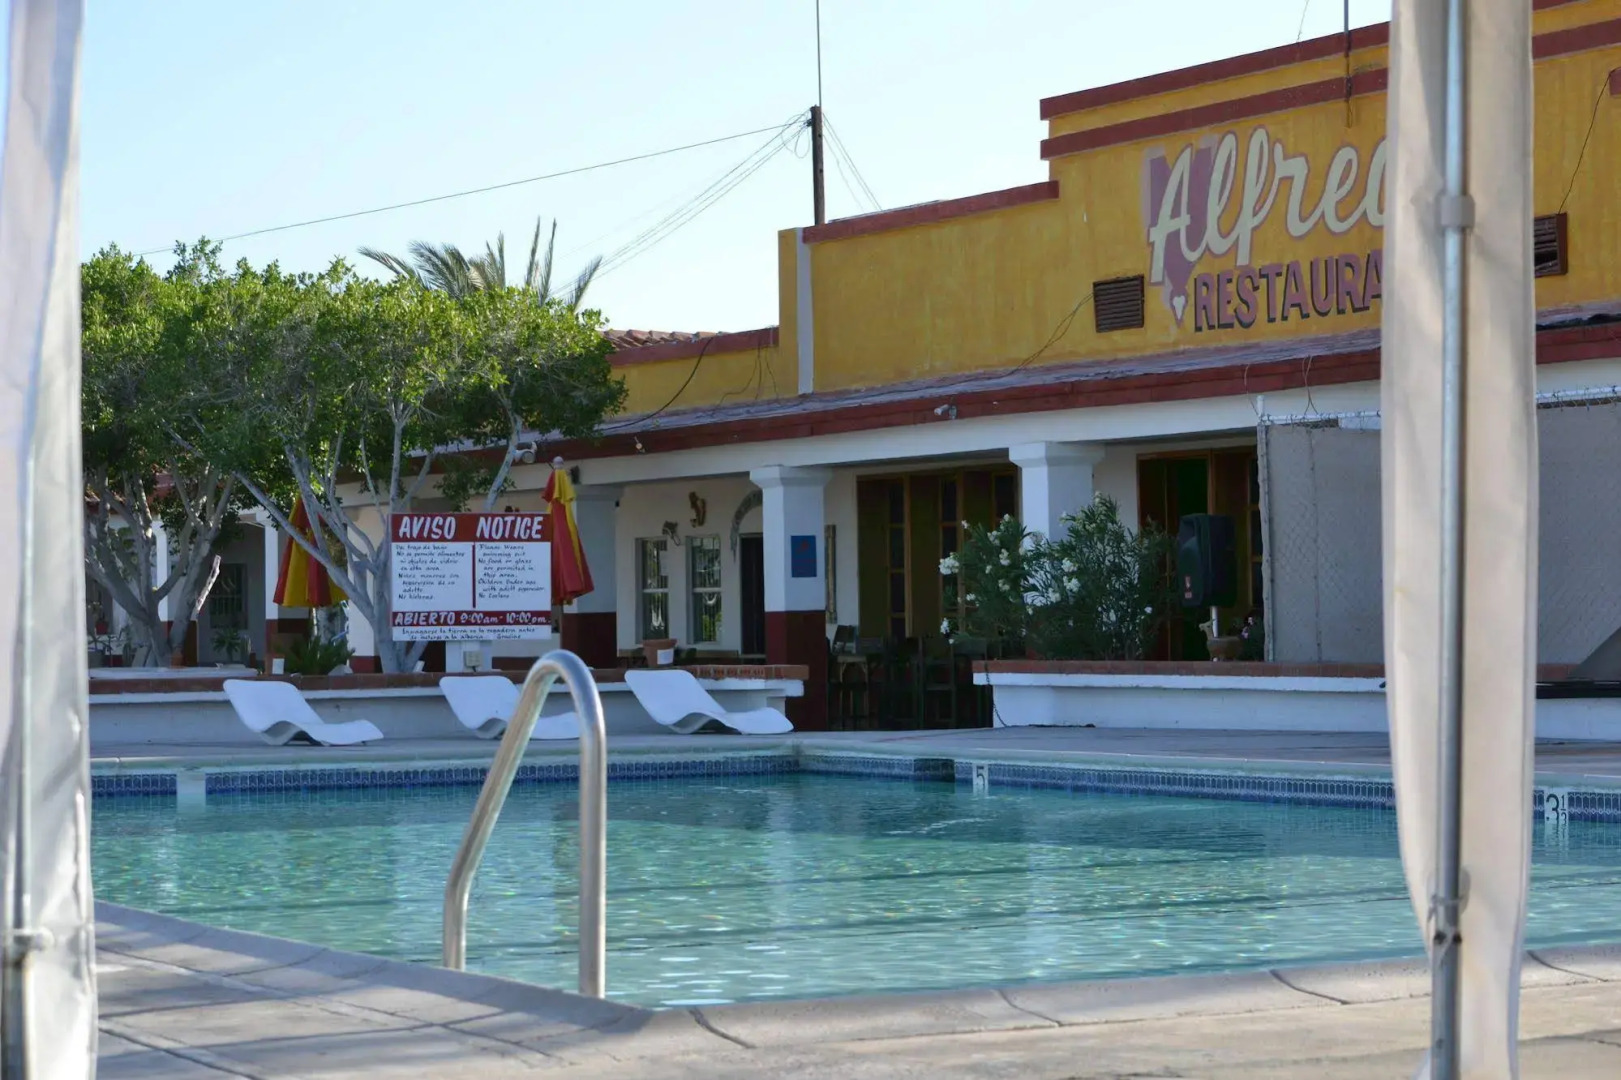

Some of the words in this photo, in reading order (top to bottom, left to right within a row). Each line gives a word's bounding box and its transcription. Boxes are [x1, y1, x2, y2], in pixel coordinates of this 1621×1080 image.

[398, 516, 456, 540] AVISO
[476, 516, 544, 540] NOTICE
[394, 612, 455, 625] ABIERTO
[976, 766, 985, 786] 5
